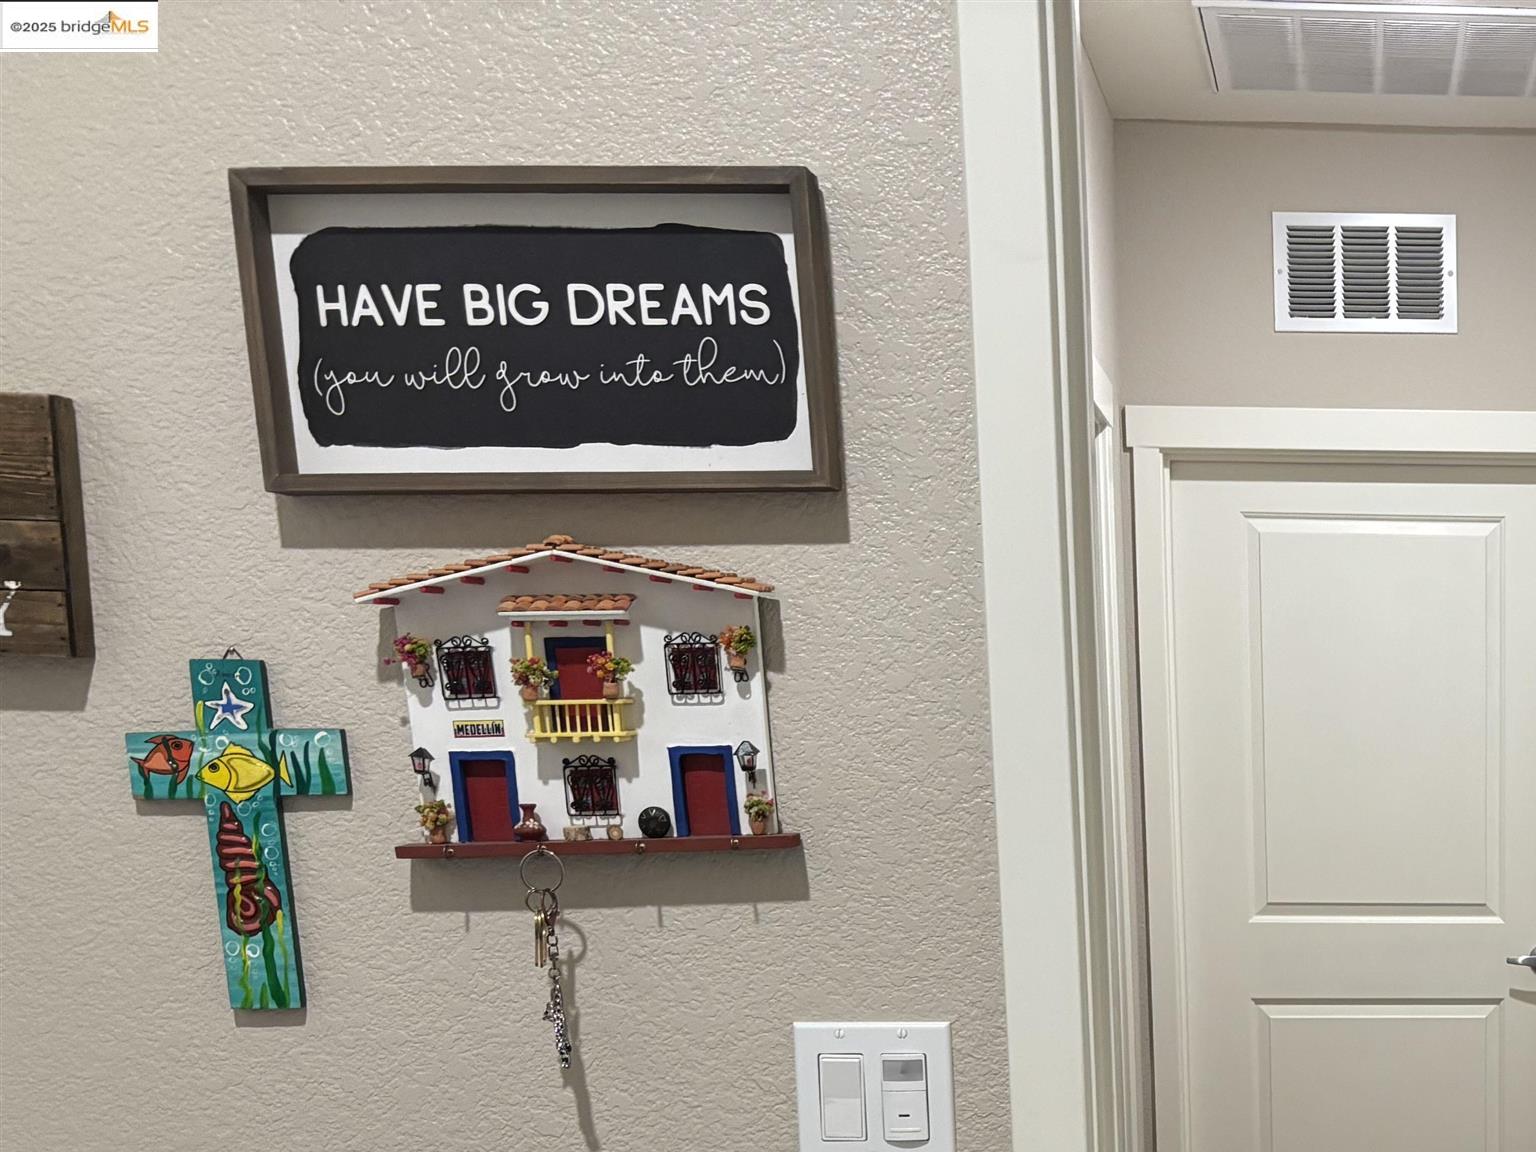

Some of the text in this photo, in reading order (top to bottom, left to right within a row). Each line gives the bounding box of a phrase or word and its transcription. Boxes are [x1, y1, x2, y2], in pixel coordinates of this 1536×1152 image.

[315, 282, 771, 328] HAVE BIG DREAMS
[313, 336, 787, 416] (you will grow into them)
[456, 720, 501, 736] MEDELLÍN
